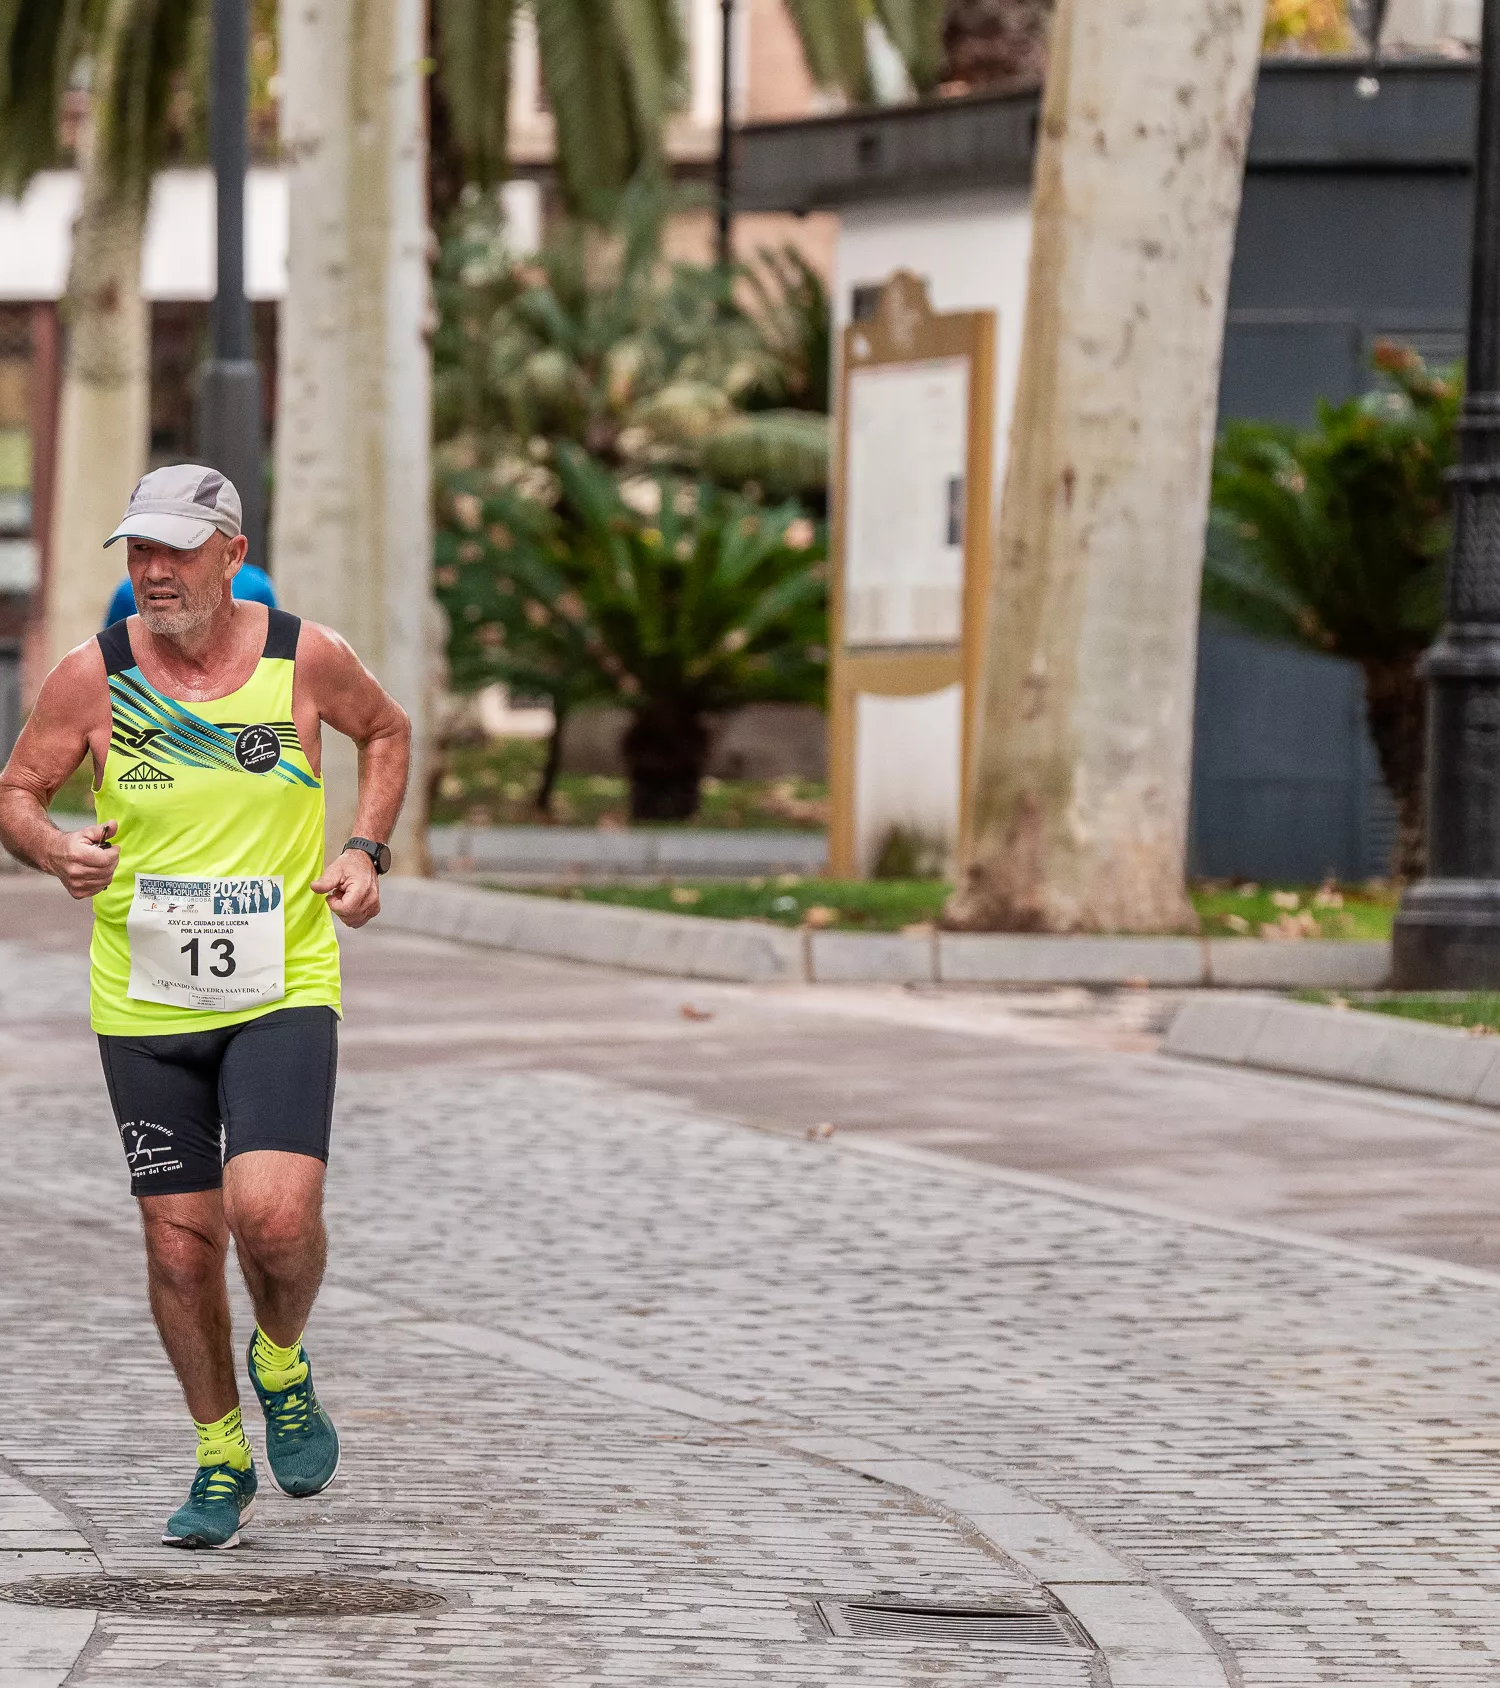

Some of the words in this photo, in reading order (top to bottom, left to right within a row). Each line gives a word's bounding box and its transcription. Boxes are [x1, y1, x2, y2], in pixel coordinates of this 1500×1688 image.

[139, 887, 172, 896] CARRERAS
[173, 888, 211, 898] POPULARES
[166, 881, 201, 890] PROVINCIAL
[202, 882, 211, 890] DE
[212, 881, 252, 897] 2024
[180, 938, 236, 977] 13
[157, 979, 190, 989] FERNANDO
[191, 985, 224, 993] SAAVEDRA
[148, 1167, 159, 1175] del
[162, 1161, 183, 1172] Canal
